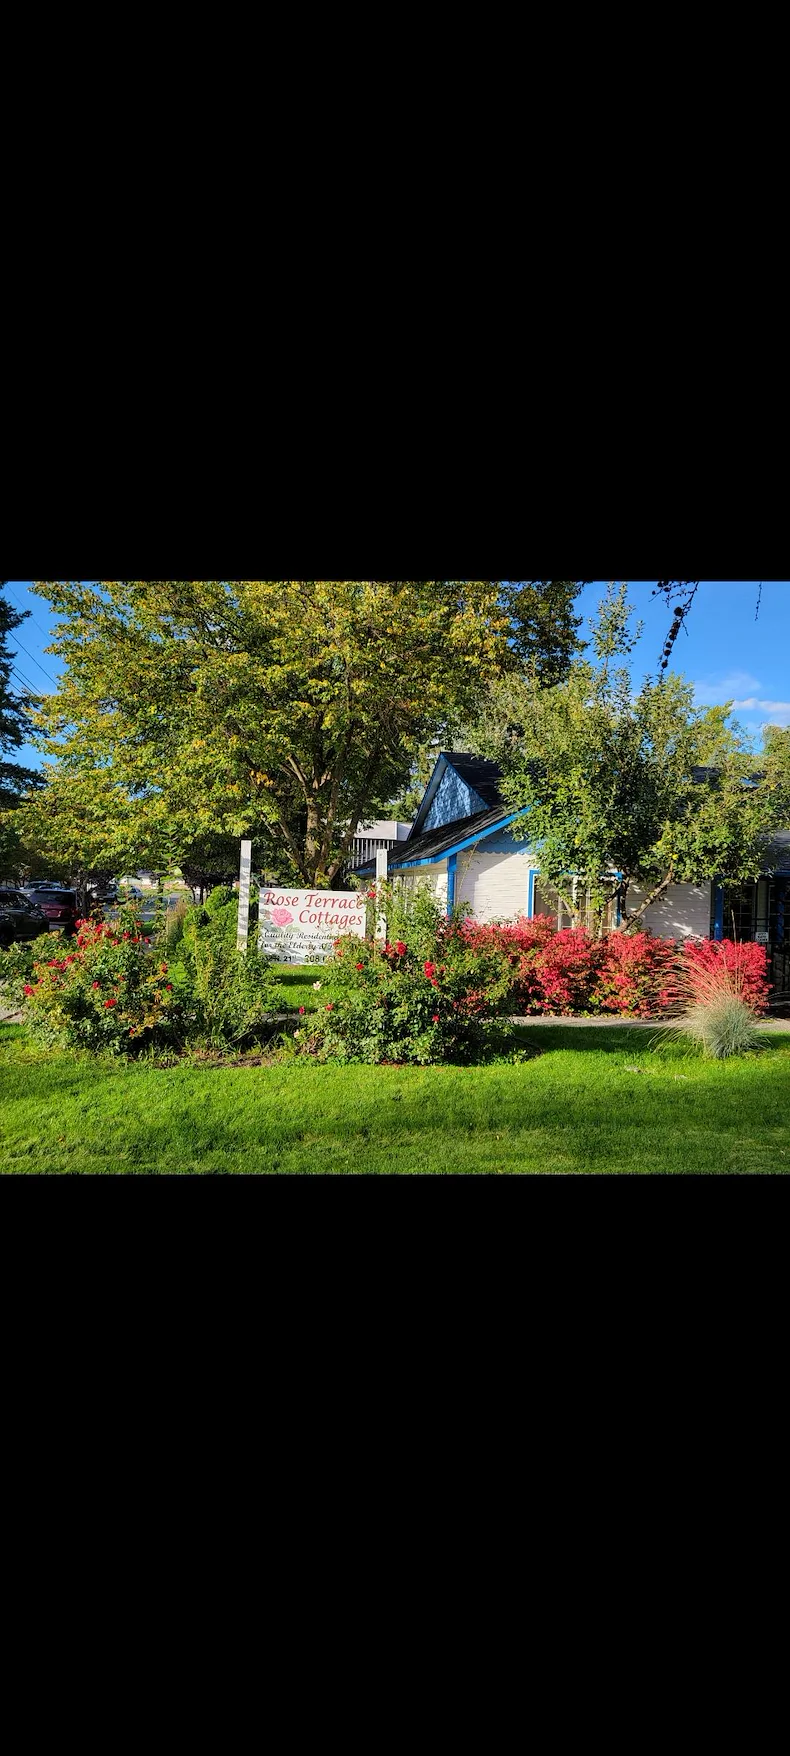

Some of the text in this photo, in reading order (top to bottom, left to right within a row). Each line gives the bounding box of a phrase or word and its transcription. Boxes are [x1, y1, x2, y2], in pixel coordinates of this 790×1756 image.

[263, 891, 364, 909] Rose Terrace
[298, 910, 363, 930] Cottages
[264, 931, 293, 940] Quality
